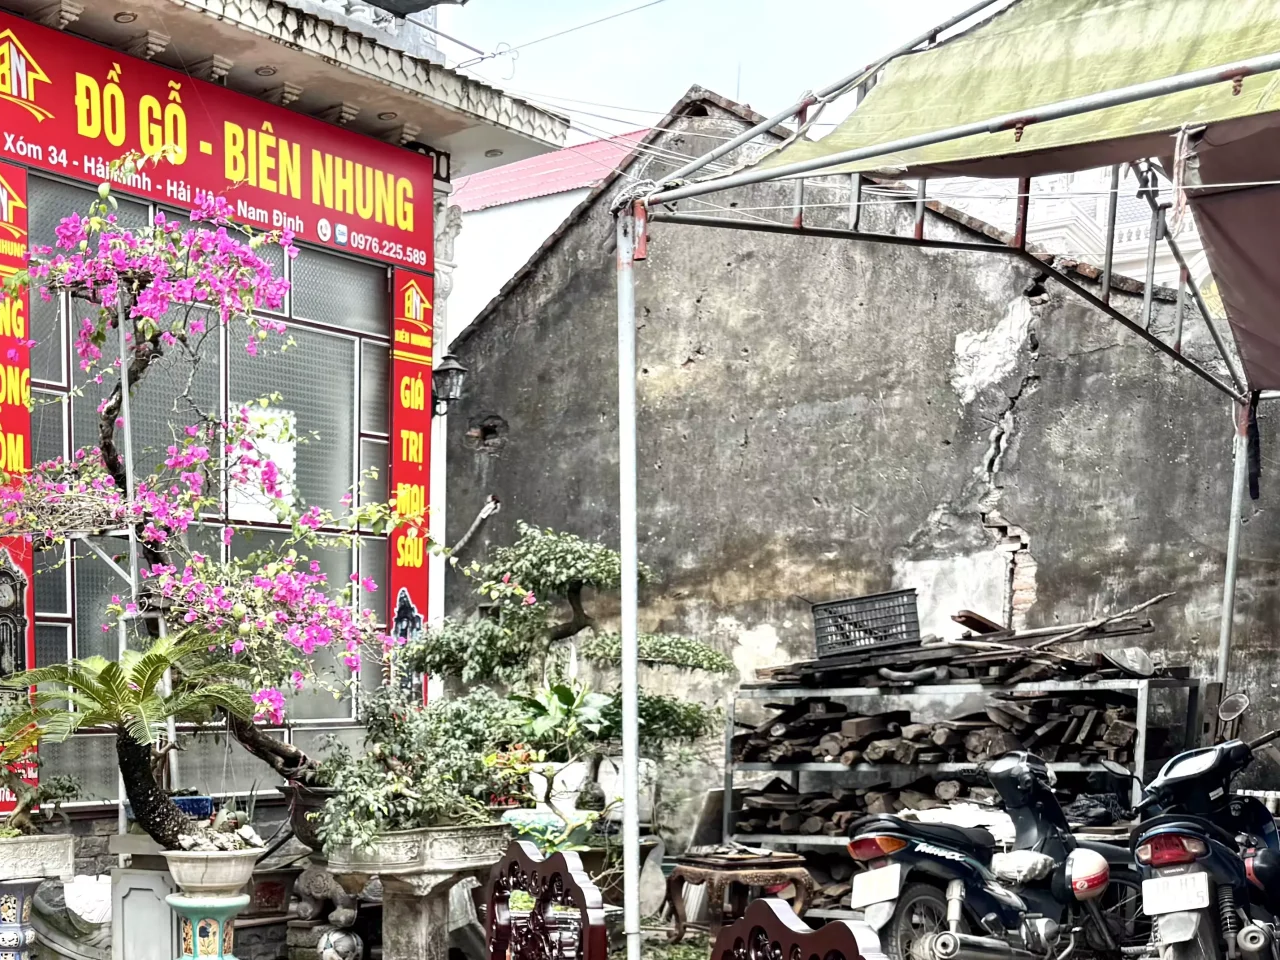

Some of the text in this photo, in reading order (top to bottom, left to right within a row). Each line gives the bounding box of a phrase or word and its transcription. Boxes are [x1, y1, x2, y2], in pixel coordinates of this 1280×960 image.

[75, 62, 126, 147] ĐỒ
[139, 80, 187, 165] GỖ
[224, 121, 301, 199] BIÊN
[312, 149, 414, 232] NHUNG
[3, 131, 43, 161] Xóm
[48, 146, 68, 168] 34
[83, 154, 110, 180] Hải
[166, 179, 191, 203] Hải
[237, 199, 269, 224] Nam
[350, 231, 427, 266] 0976.225.589
[400, 371, 424, 411] GIÁ
[401, 429, 423, 471] TRỊ
[396, 482, 425, 518] MAI
[396, 535, 423, 568] SAU
